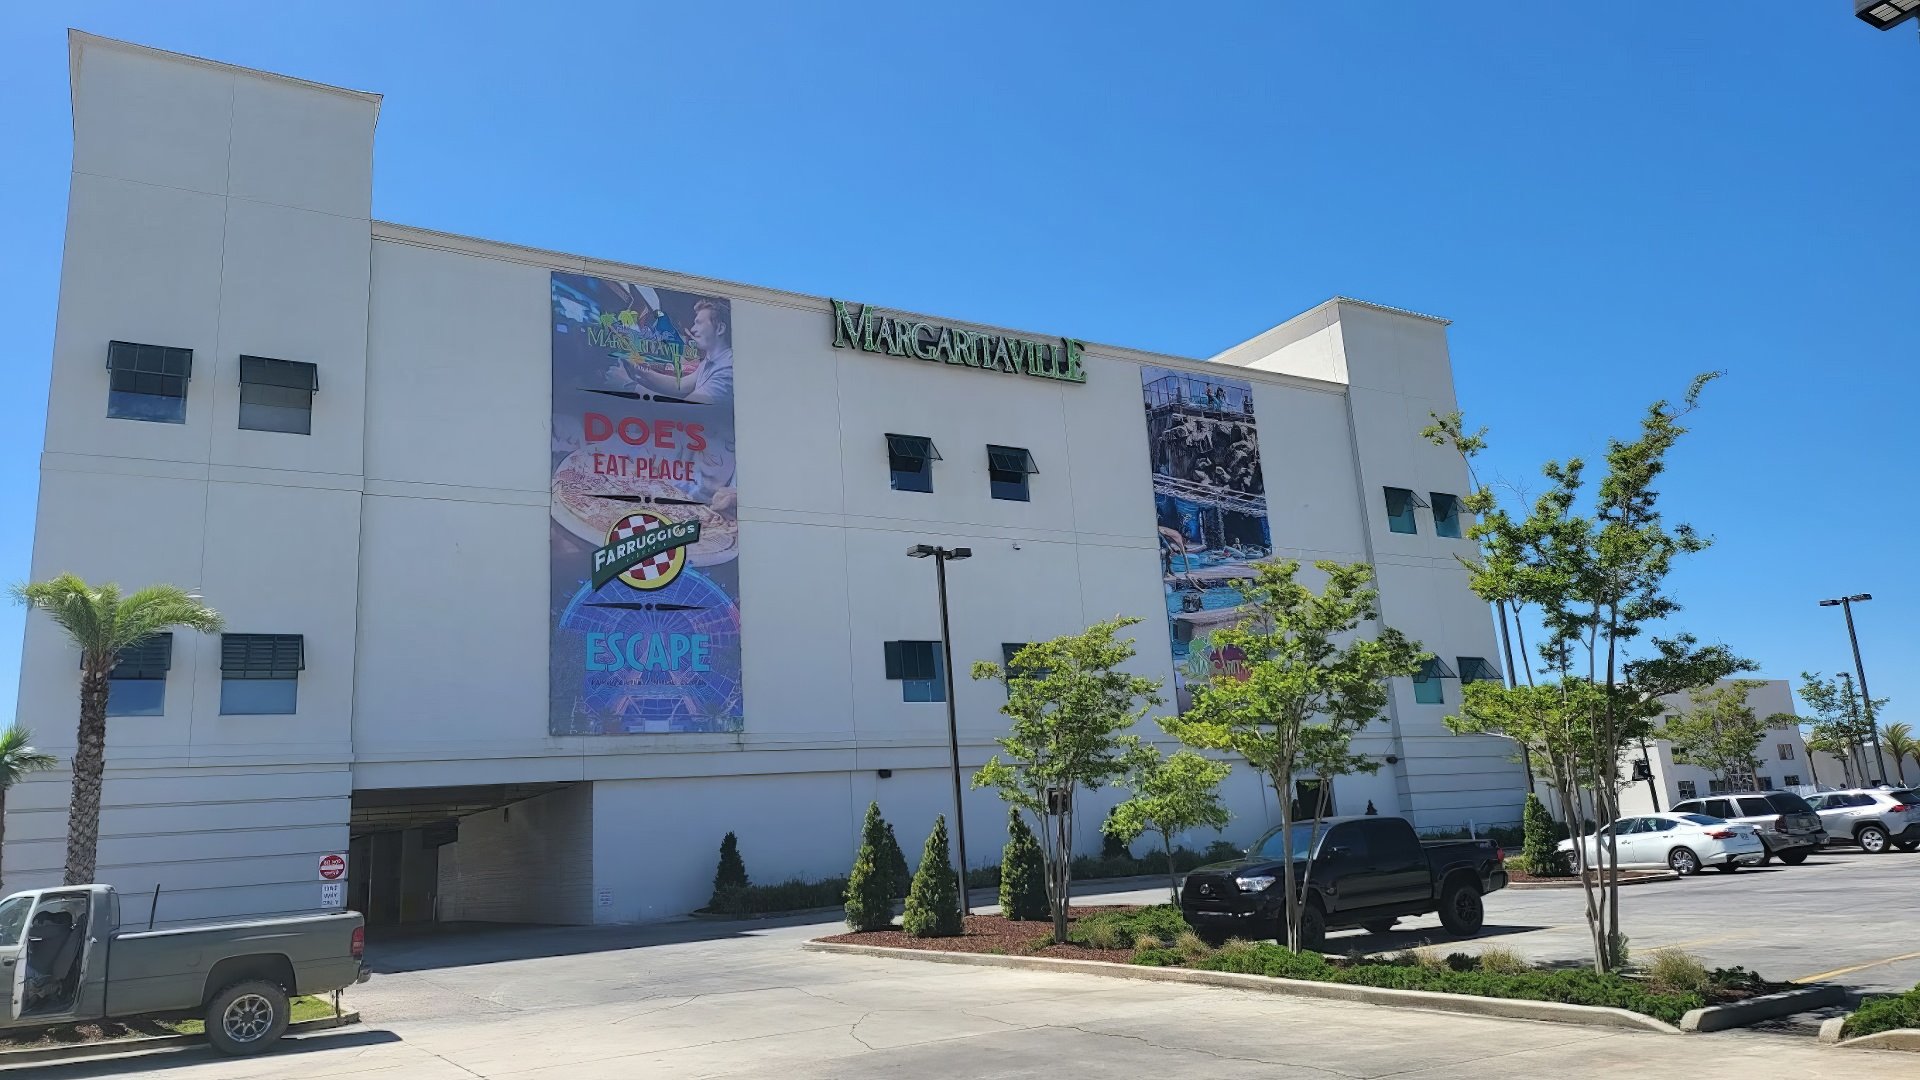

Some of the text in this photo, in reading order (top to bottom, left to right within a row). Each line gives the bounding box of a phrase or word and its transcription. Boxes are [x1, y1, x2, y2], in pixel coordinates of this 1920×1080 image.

[830, 298, 1087, 383] MARGARITAVILLE
[583, 412, 707, 452] DOE'S
[593, 453, 697, 482] EAT PLACE
[585, 632, 712, 672] ESCAPE
